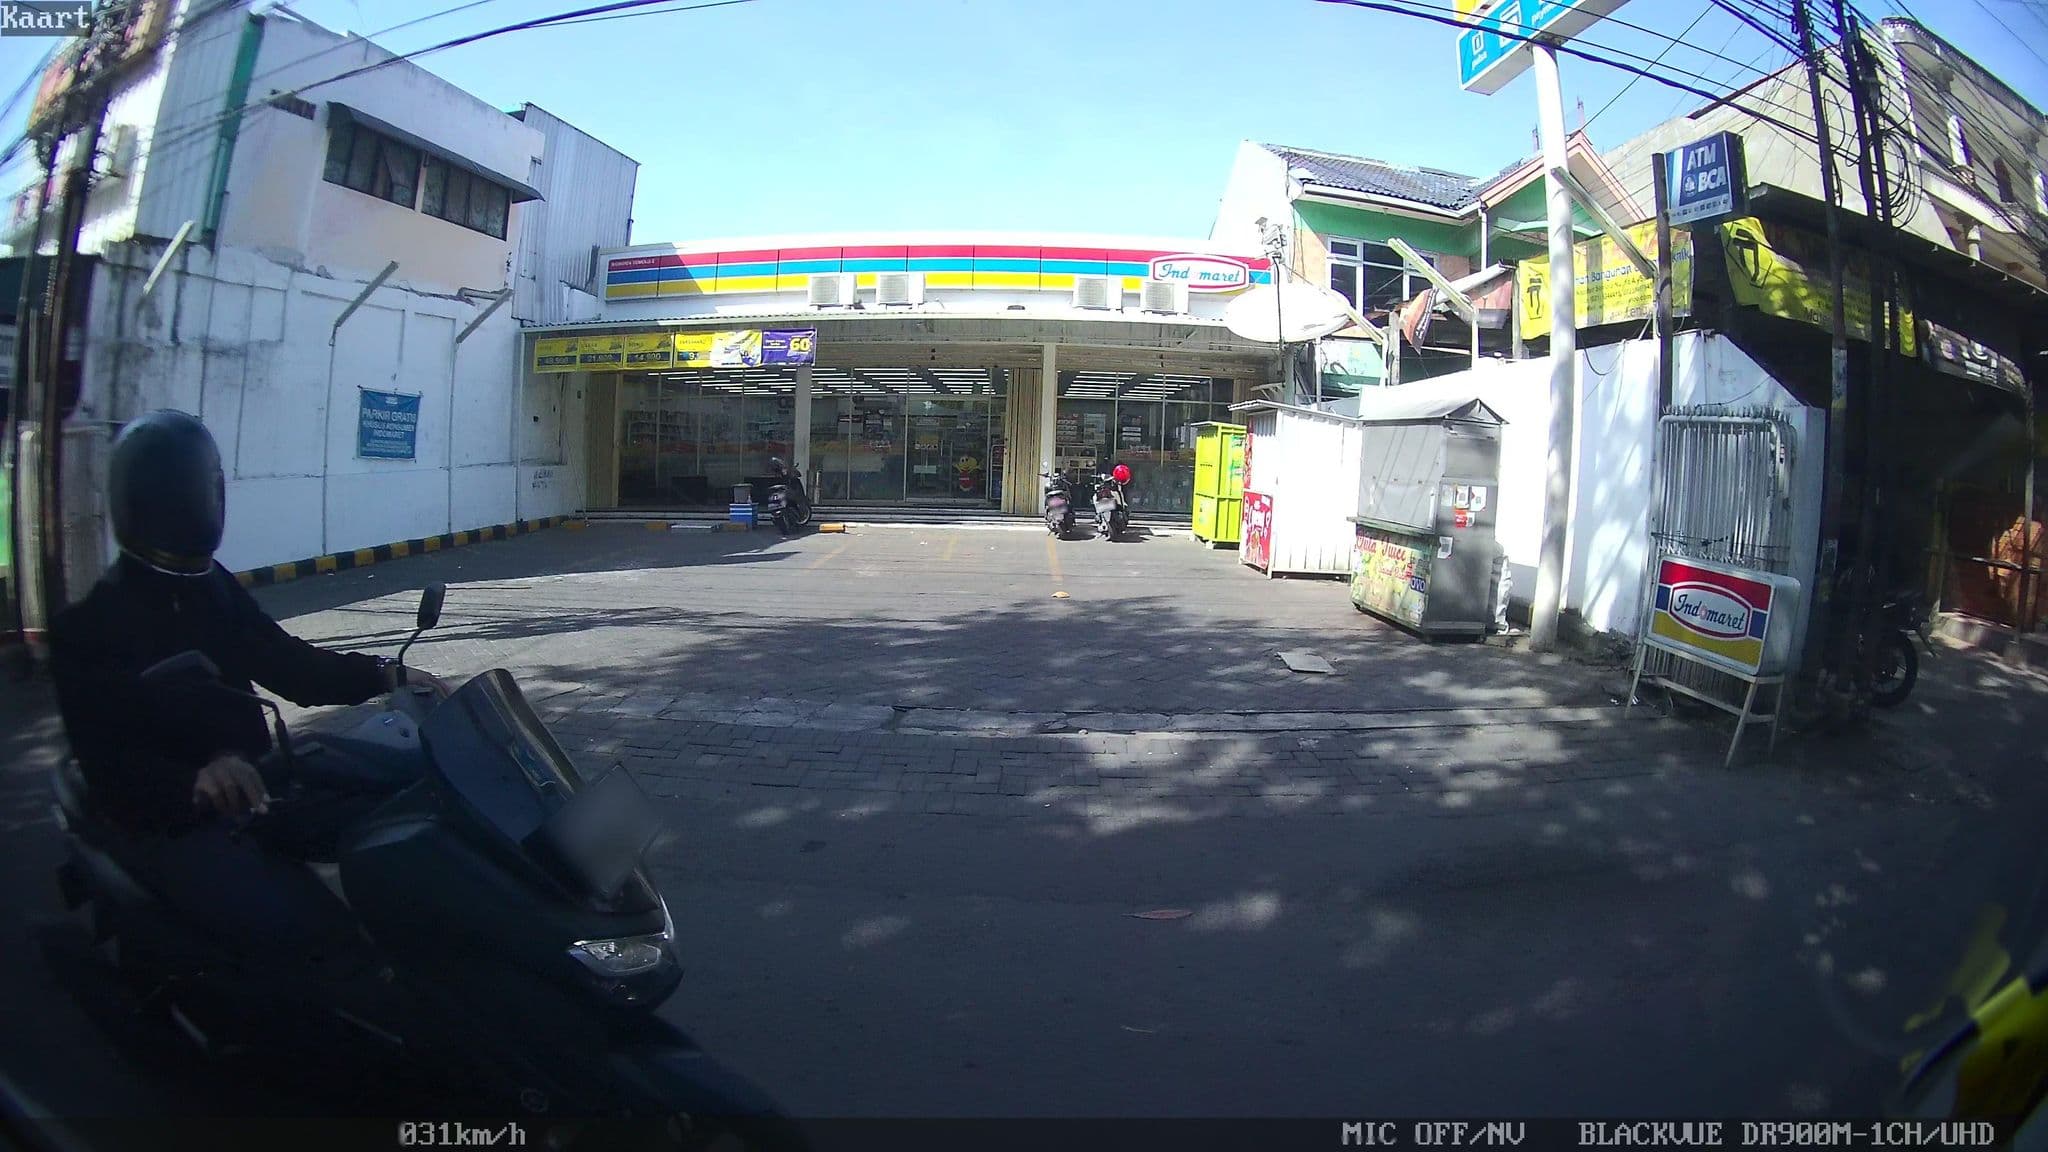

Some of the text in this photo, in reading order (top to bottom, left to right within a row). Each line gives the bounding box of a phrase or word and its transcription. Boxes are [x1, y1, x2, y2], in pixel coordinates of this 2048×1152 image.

[1687, 143, 1716, 171] ATM
[1698, 166, 1727, 192] BCA
[1159, 263, 1240, 283] Indmaret
[1411, 577, 1426, 592] OVO
[1673, 594, 1746, 630] Indomaret
